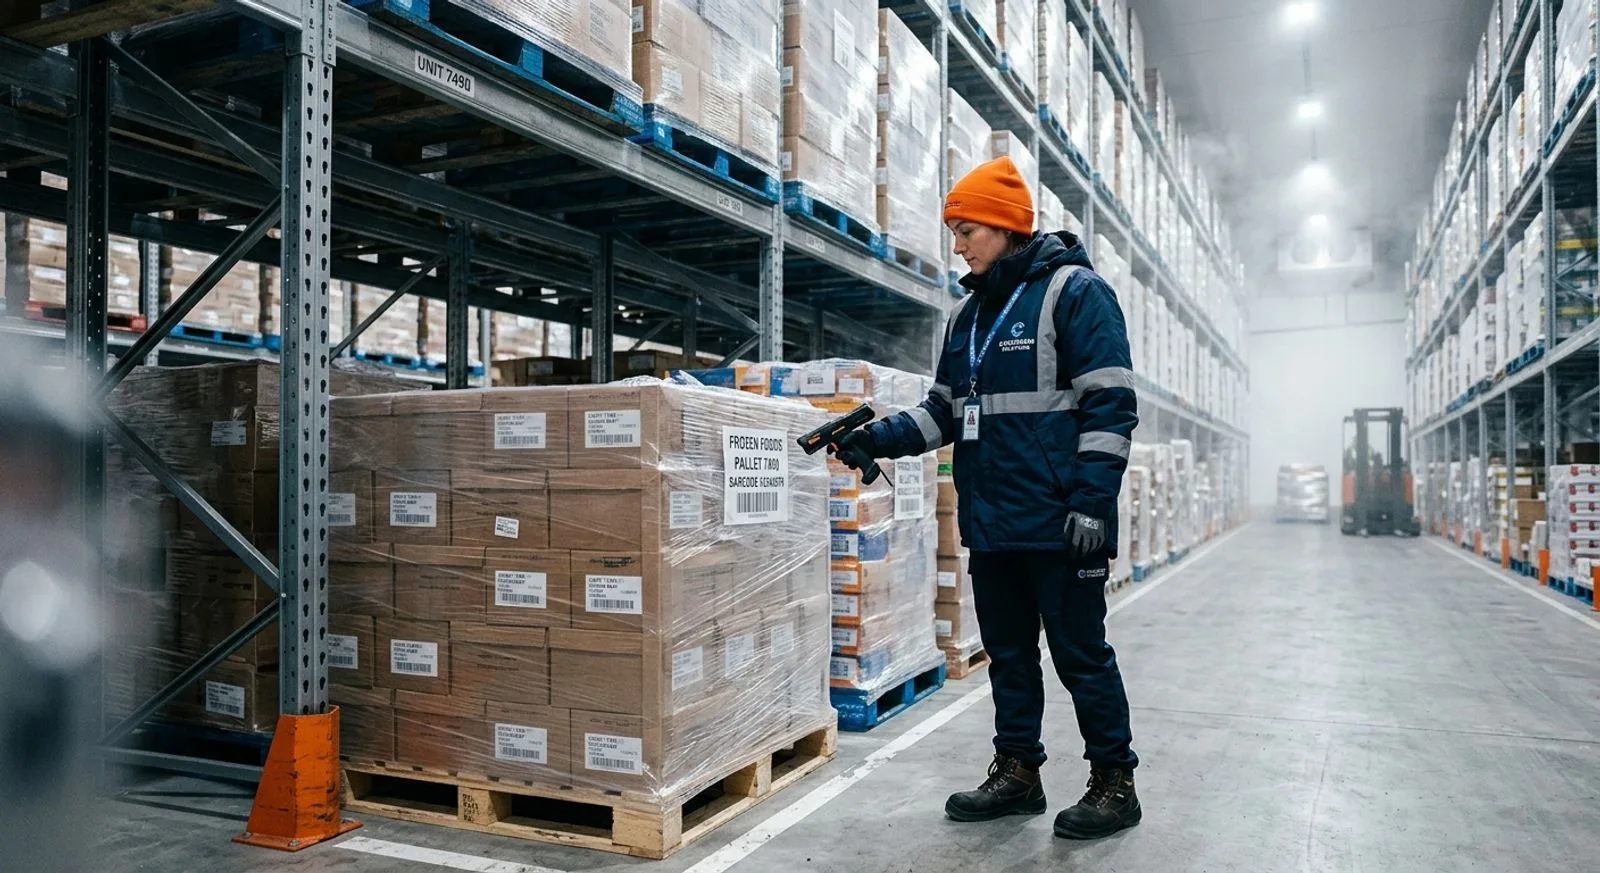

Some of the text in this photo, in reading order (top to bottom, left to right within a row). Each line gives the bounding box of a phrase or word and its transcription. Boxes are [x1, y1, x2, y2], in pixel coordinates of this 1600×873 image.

[418, 56, 471, 92] UNIT 7490
[734, 456, 762, 470] PALLET
